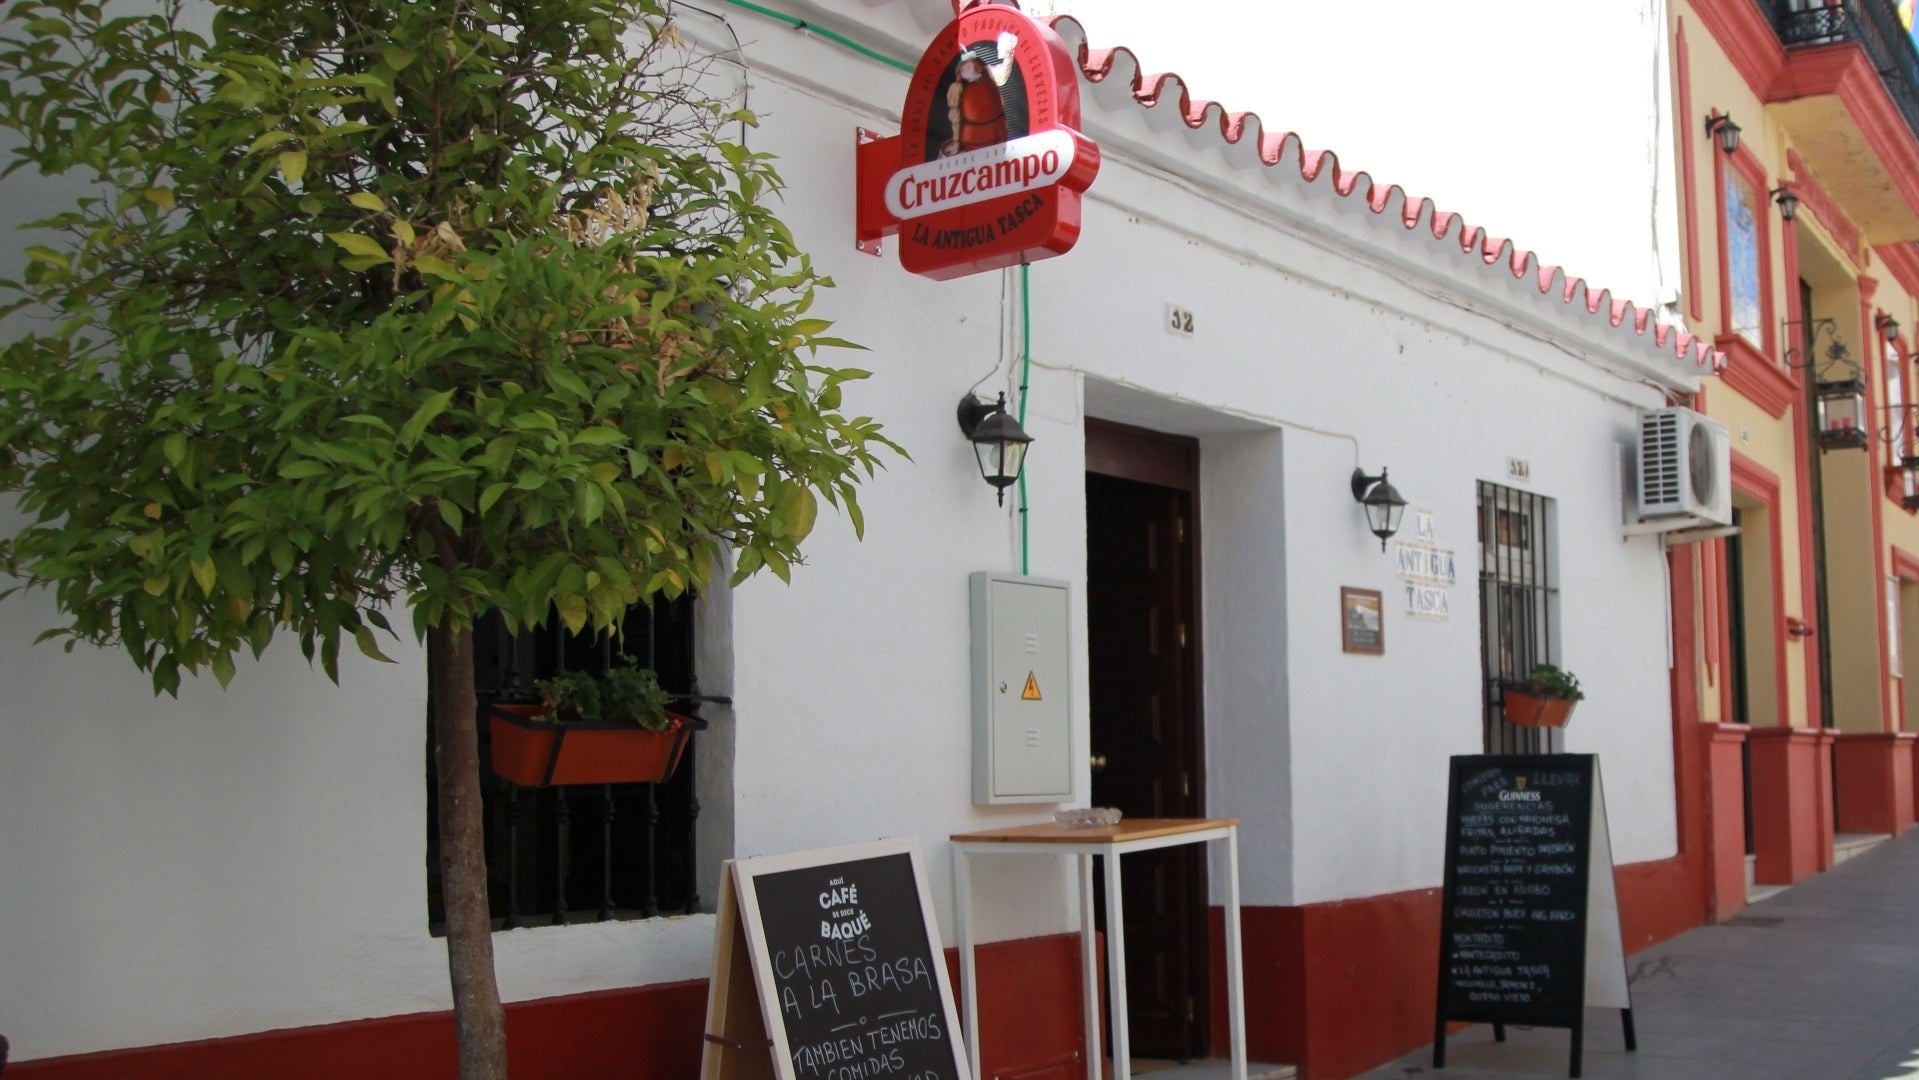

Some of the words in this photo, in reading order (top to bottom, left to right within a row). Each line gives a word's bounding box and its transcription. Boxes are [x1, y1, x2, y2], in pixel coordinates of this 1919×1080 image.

[1028, 55, 1048, 125] CERVEZAS
[900, 150, 1059, 210] Cruzcampo
[911, 222, 930, 246] LA
[932, 222, 996, 250] ANTIGUA
[997, 193, 1045, 236] TASCA
[1418, 514, 1434, 539] LA
[1398, 553, 1455, 578] ANTIGUA
[1406, 586, 1448, 614] TASCA
[1474, 801, 1554, 811] SUGERENCIAS
[1490, 845, 1535, 857] PIMIENTO
[819, 883, 858, 909] CAFÉ
[821, 909, 872, 940] BAQUÉ
[832, 911, 839, 919] SE
[840, 908, 855, 918] DICE
[775, 935, 877, 980] CARNES
[783, 986, 802, 1020] A
[809, 980, 840, 1015] LA
[848, 957, 932, 998] BRASA
[793, 1036, 863, 1077] TAMBIEN
[866, 1013, 941, 1050] TENEMOS
[827, 1048, 905, 1080] COMIDAS
